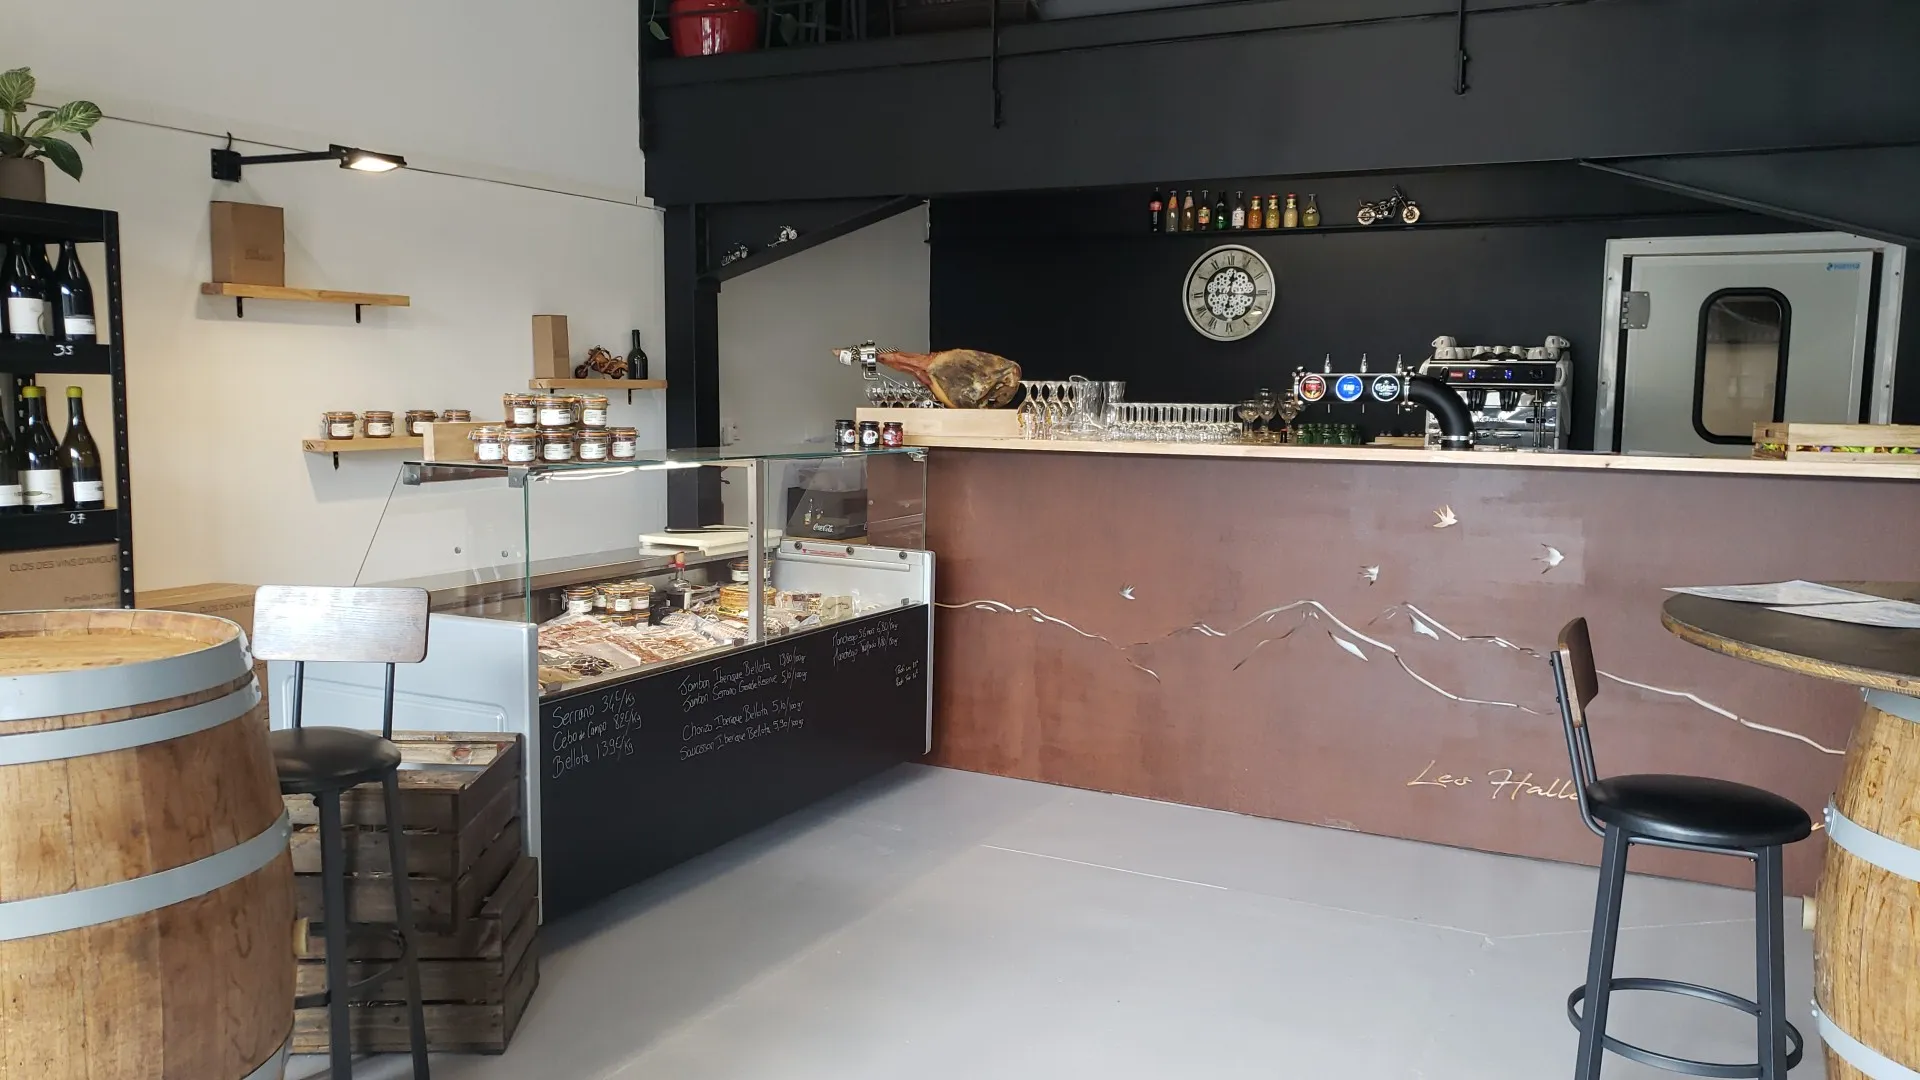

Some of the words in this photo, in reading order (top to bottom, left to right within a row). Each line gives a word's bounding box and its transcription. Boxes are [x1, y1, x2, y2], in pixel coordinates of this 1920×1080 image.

[68, 513, 86, 524] 27
[9, 563, 34, 572] CLOS
[35, 560, 54, 570] DES
[57, 558, 76, 568] VINS
[552, 704, 595, 729] Serrano
[552, 729, 578, 752] Cebo
[587, 721, 607, 738] Campo
[552, 745, 590, 778] Bellota
[1407, 759, 1472, 788] Les
[1487, 768, 1579, 801] Halle
